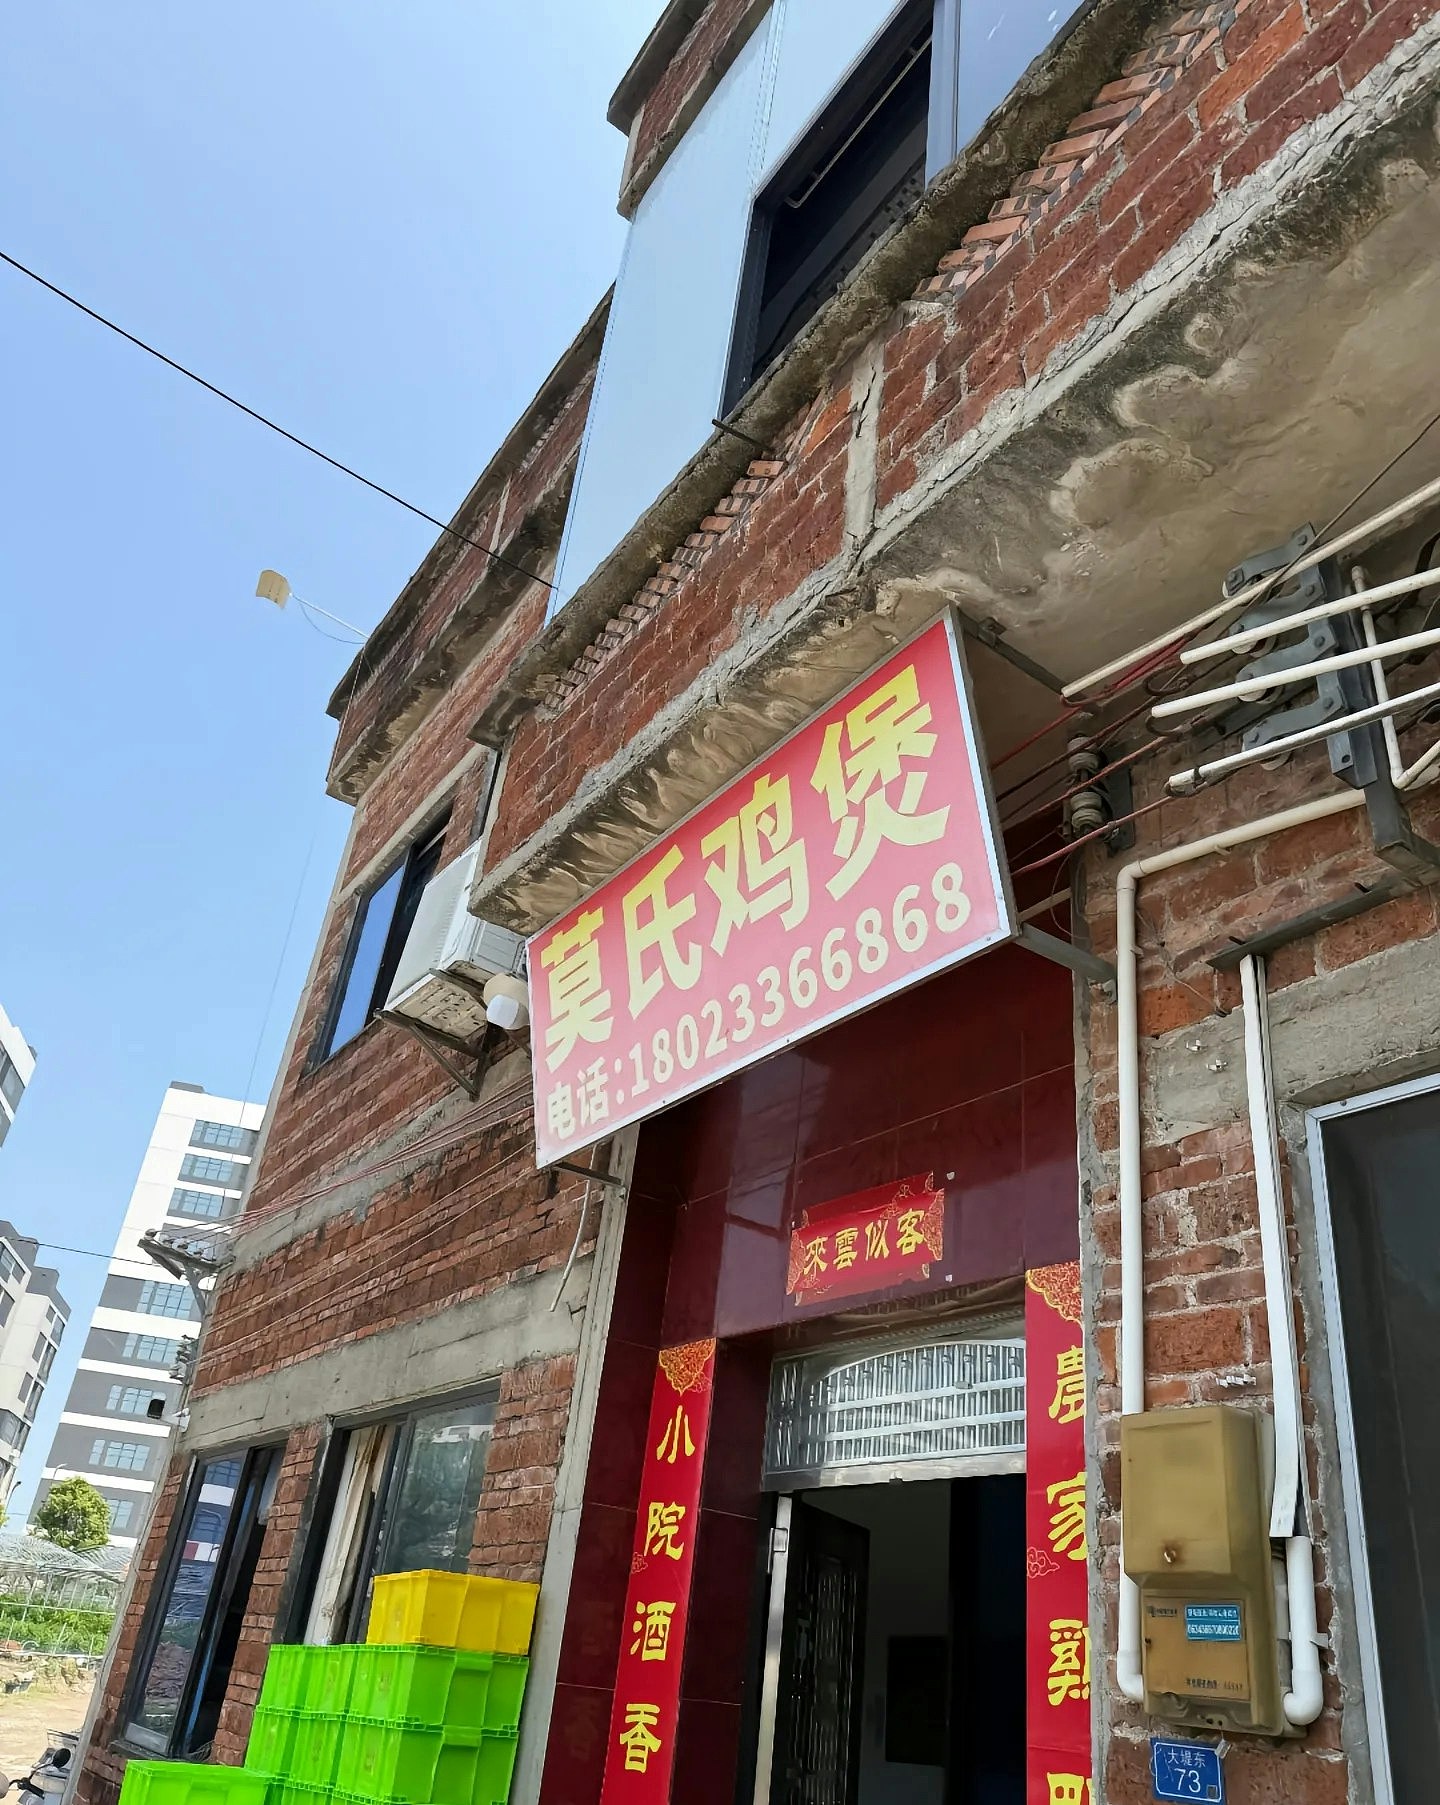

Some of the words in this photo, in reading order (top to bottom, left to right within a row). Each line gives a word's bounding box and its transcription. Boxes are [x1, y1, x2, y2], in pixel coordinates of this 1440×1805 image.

[541, 664, 950, 1073] 莫氏鸡煲
[546, 862, 971, 1140] 电话:18023366868
[619, 1405, 696, 1773] 小院酒香
[1168, 1747, 1206, 1768] 大堤东
[1174, 1767, 1201, 1793] 73
